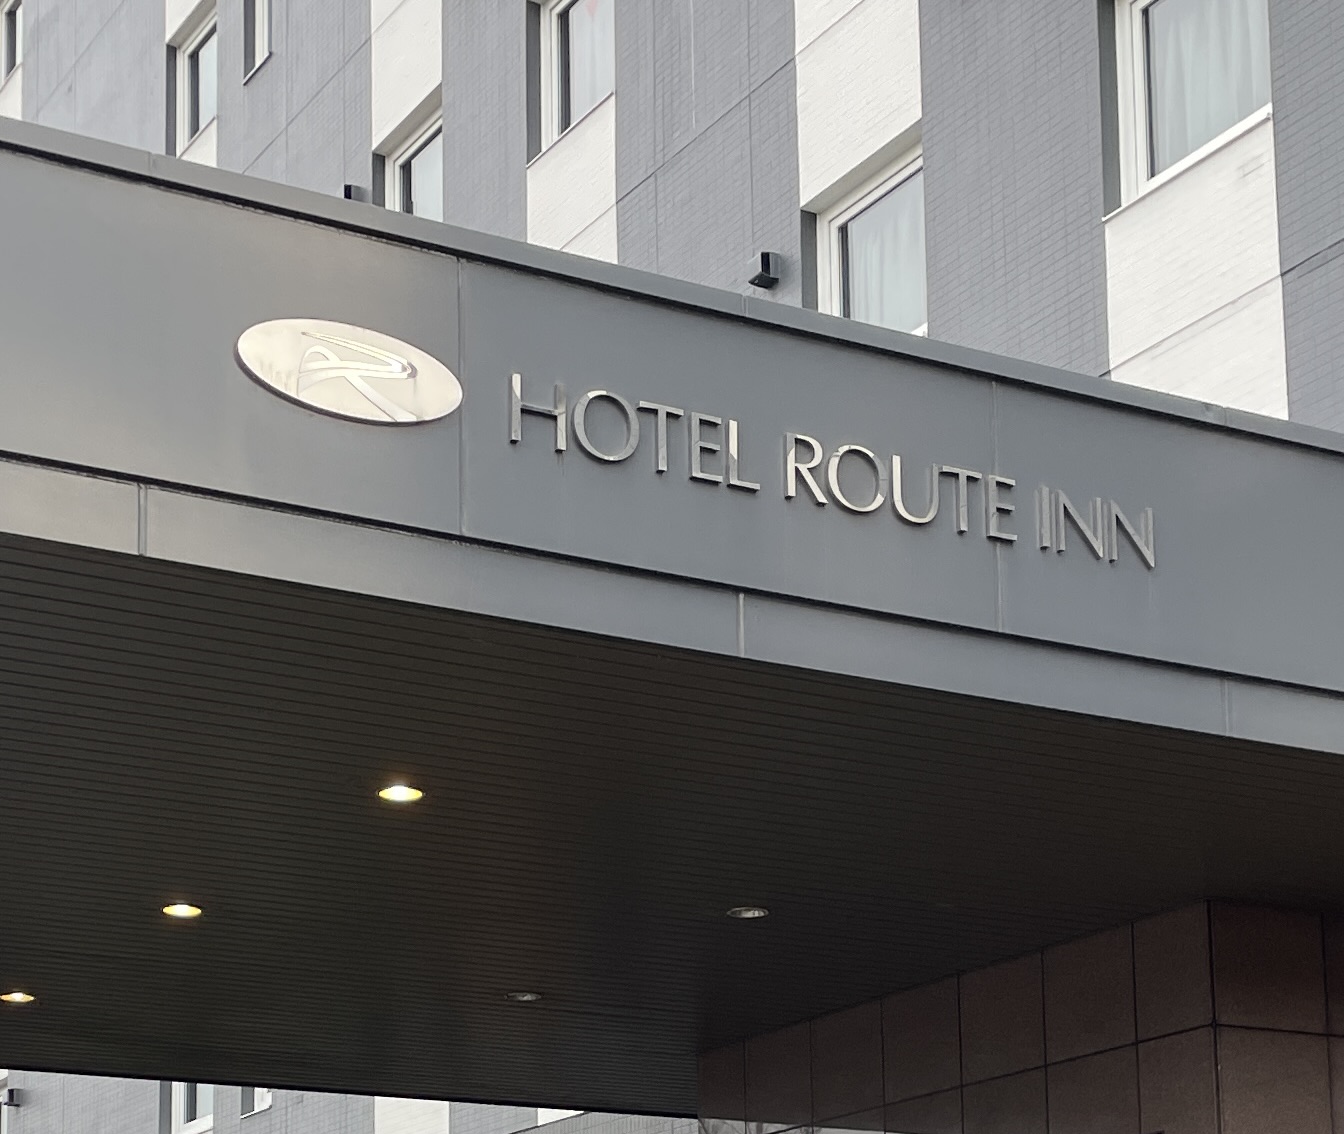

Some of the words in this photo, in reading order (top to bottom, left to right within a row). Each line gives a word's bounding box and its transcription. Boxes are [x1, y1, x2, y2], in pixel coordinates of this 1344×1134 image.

[510, 373, 760, 491] HOTEL
[784, 432, 1018, 542] ROUTE
[1036, 485, 1155, 568] INN
